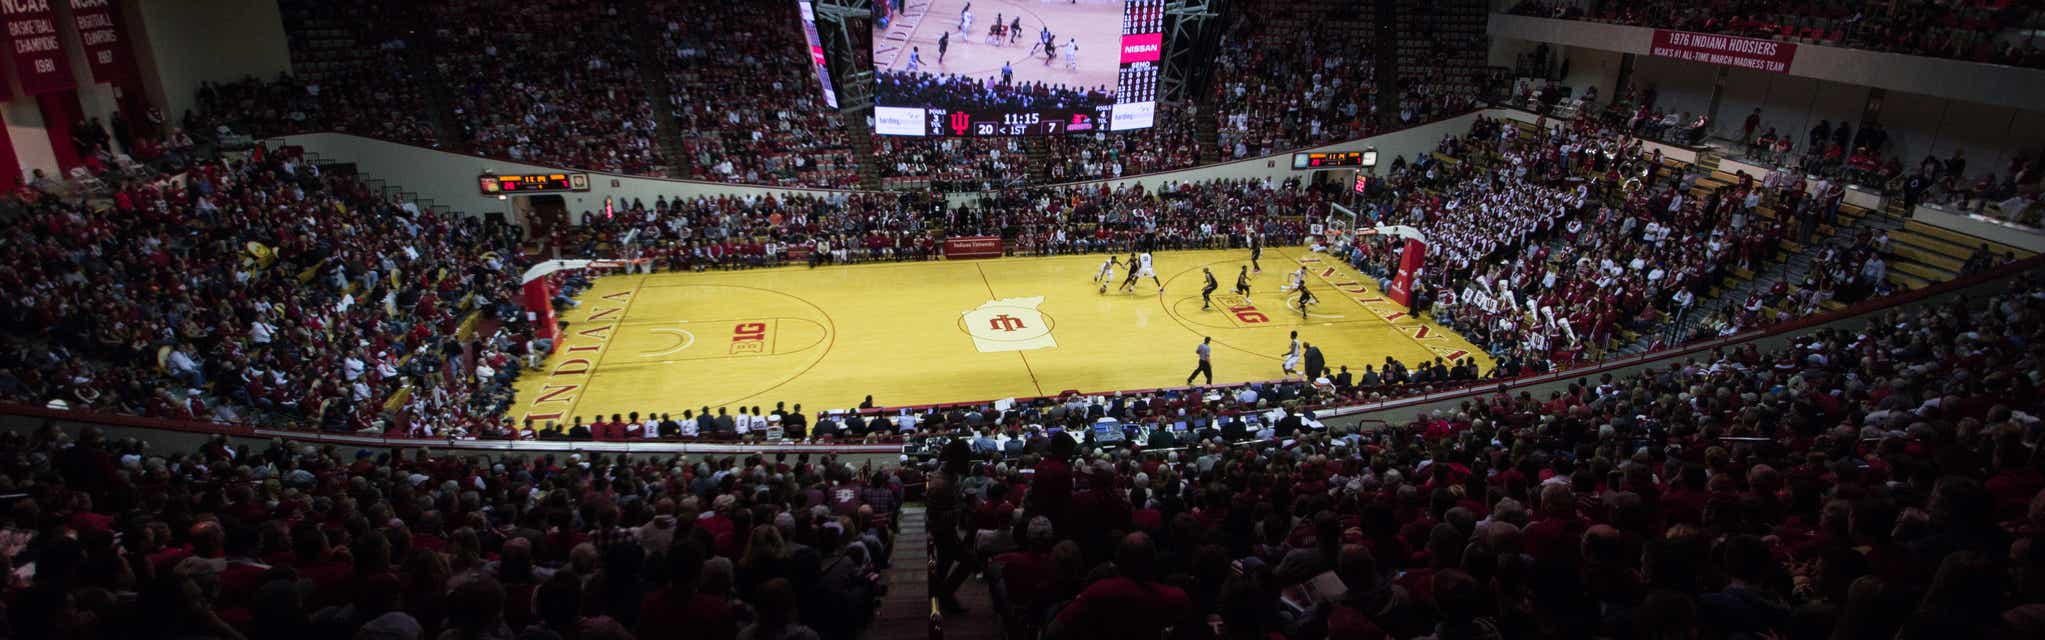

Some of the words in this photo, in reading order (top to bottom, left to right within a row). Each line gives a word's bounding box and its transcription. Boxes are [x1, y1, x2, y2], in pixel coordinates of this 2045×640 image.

[1124, 44, 1158, 54] NISSAN
[1669, 33, 1689, 46] 1976
[1691, 34, 1727, 50] INDIANA
[1728, 39, 1778, 56] HOOSIERS
[1682, 52, 1711, 62] ALL-TIME
[1712, 54, 1732, 64] MARCH
[1733, 58, 1766, 69] MADNESS
[1766, 61, 1784, 72] TEAM
[1004, 113, 1039, 124] 11:15
[978, 124, 993, 134] 20
[1010, 126, 1027, 135] 1ST
[1049, 123, 1056, 133] 7
[1301, 258, 1470, 361] INDIANA
[522, 289, 632, 422] INDIANA
